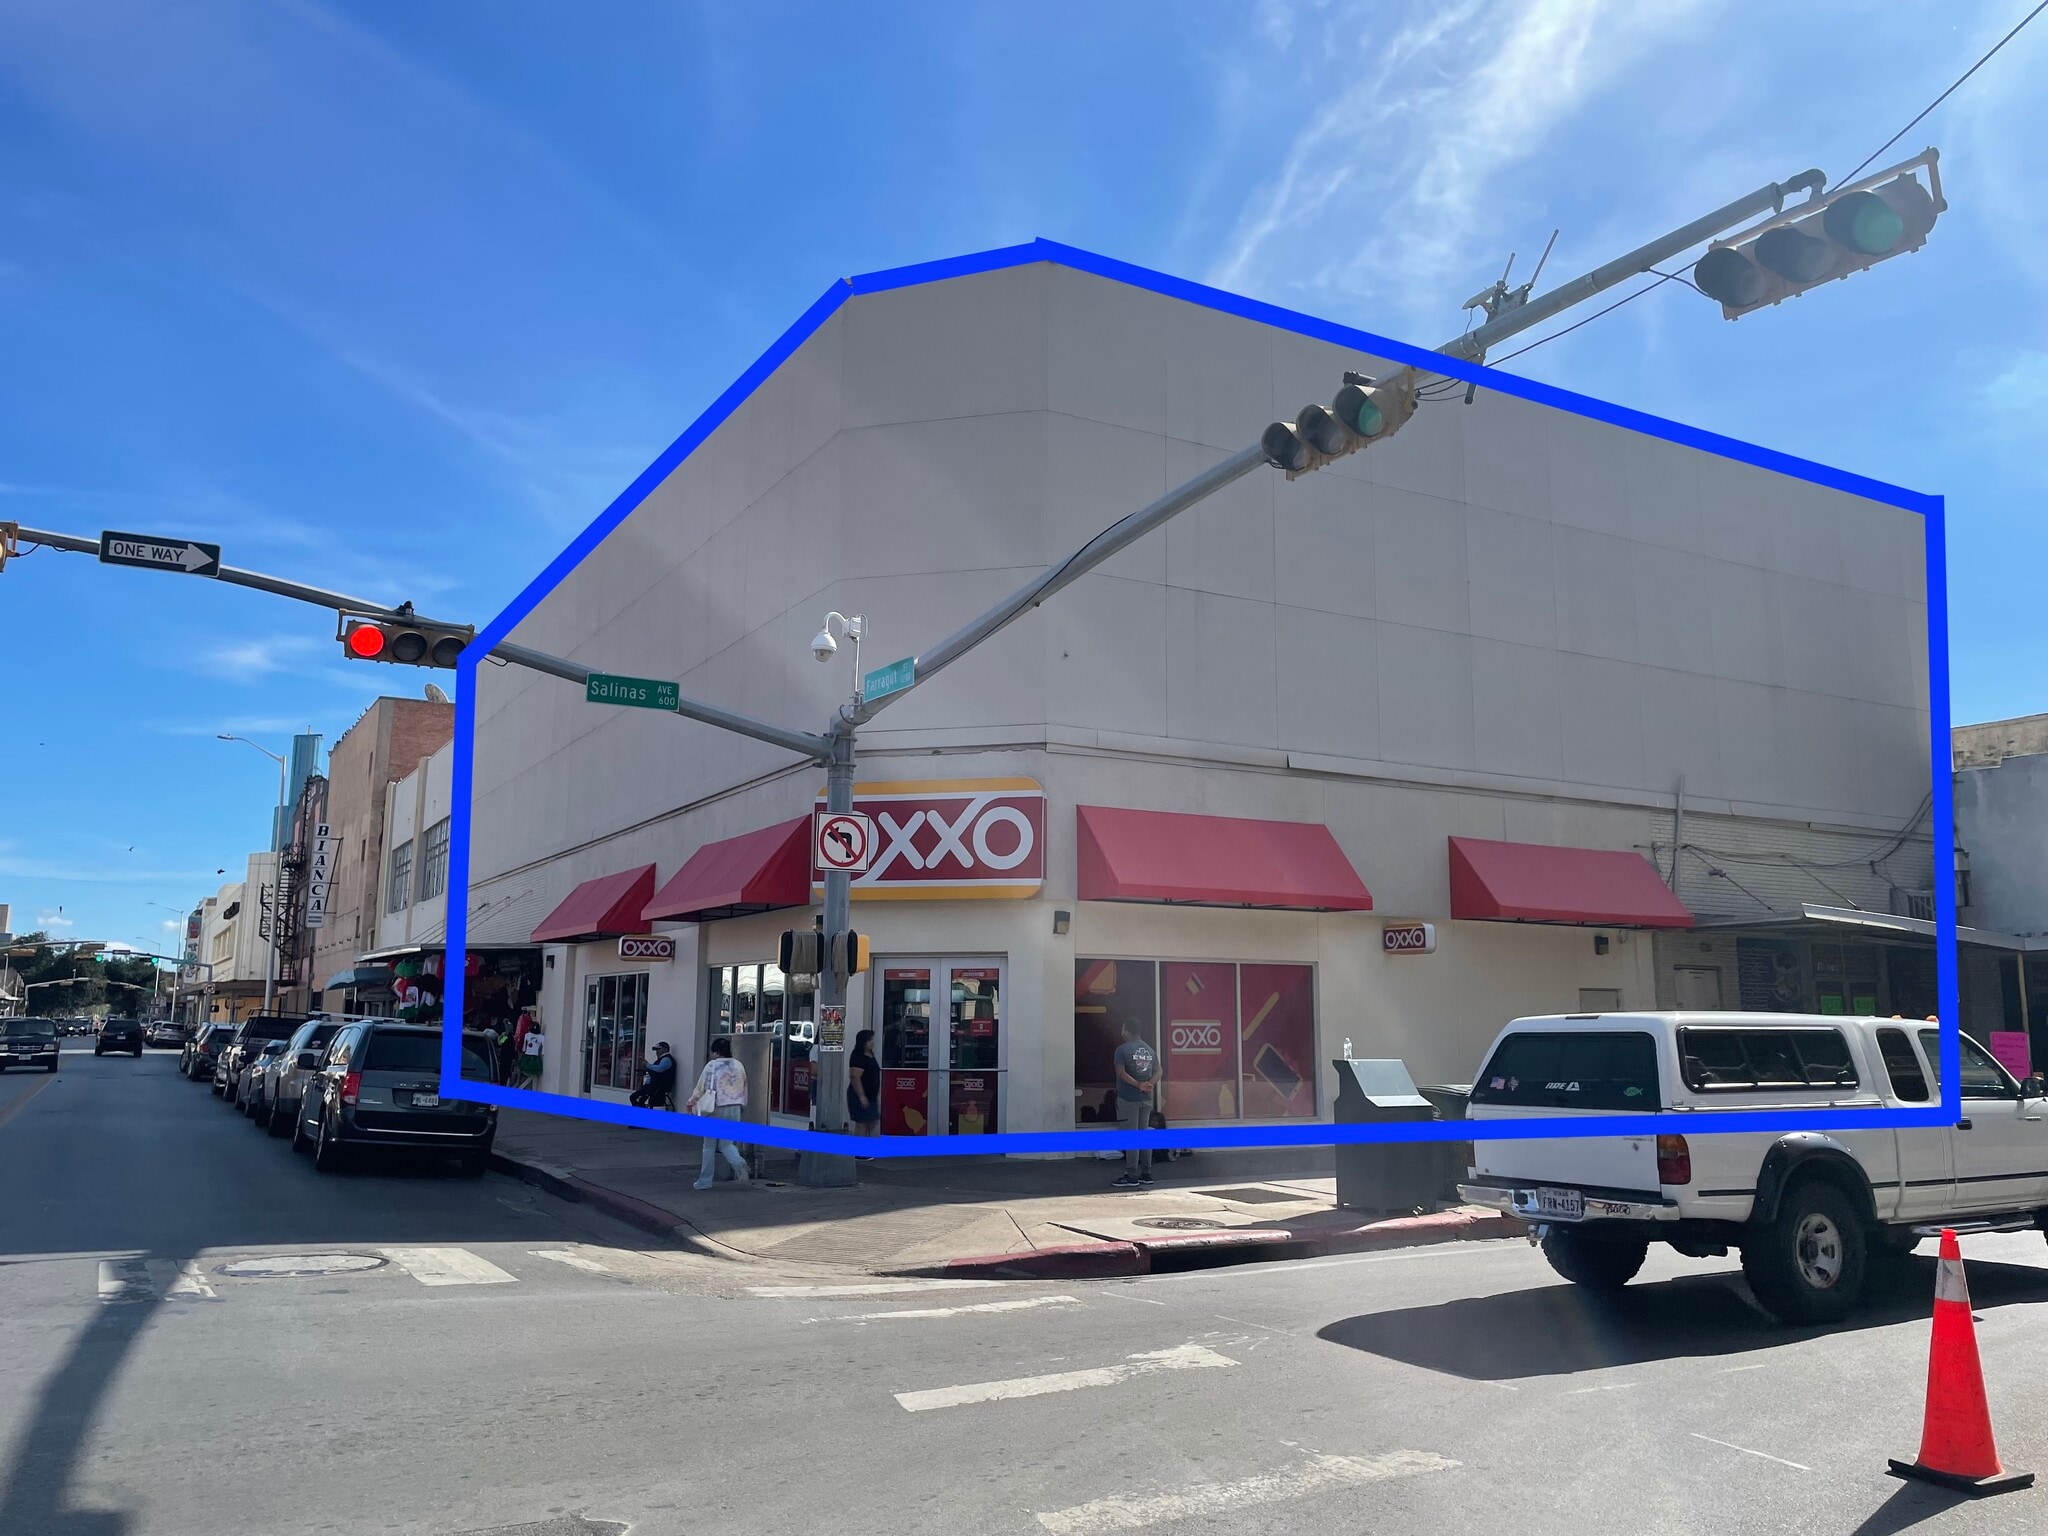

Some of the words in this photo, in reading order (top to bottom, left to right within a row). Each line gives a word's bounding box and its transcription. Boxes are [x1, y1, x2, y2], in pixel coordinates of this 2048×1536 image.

[113, 542, 145, 558] ONE
[151, 547, 184, 562] WAY
[591, 681, 646, 700] Salinas
[657, 685, 672, 695] AVE
[866, 670, 897, 695] Farragut
[658, 696, 676, 706] 600
[850, 798, 1034, 885] XXO
[310, 825, 330, 911] BIANCA
[623, 940, 671, 957] OXXO
[1385, 929, 1425, 949] OXXO
[1172, 1026, 1221, 1048] OXXO
